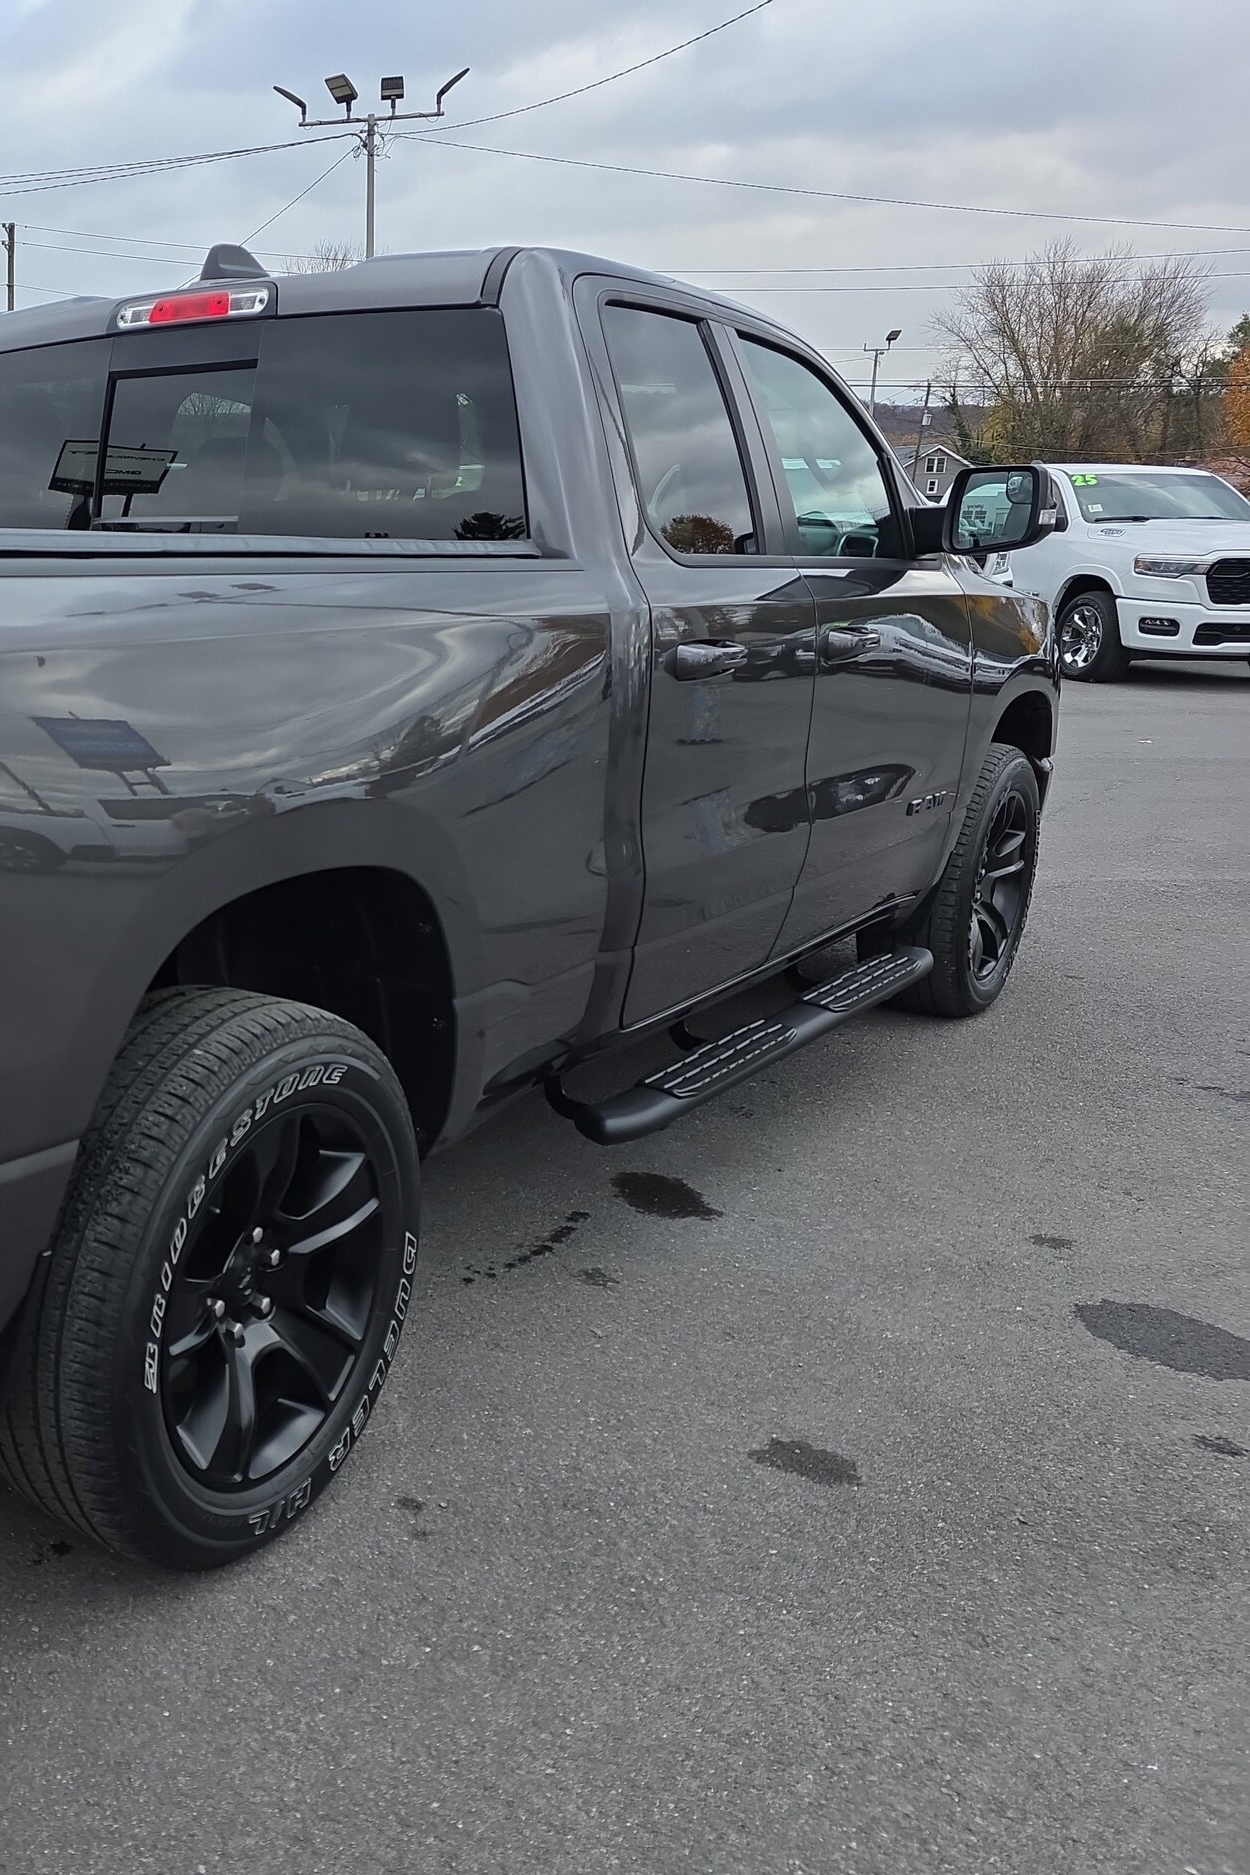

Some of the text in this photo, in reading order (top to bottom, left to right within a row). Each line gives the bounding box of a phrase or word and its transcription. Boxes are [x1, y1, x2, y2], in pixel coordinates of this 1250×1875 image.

[1071, 474, 1099, 487] 25
[906, 790, 947, 816] RAM
[144, 1065, 348, 1395] BRIDGESTONE
[329, 1231, 418, 1471] DUELER
